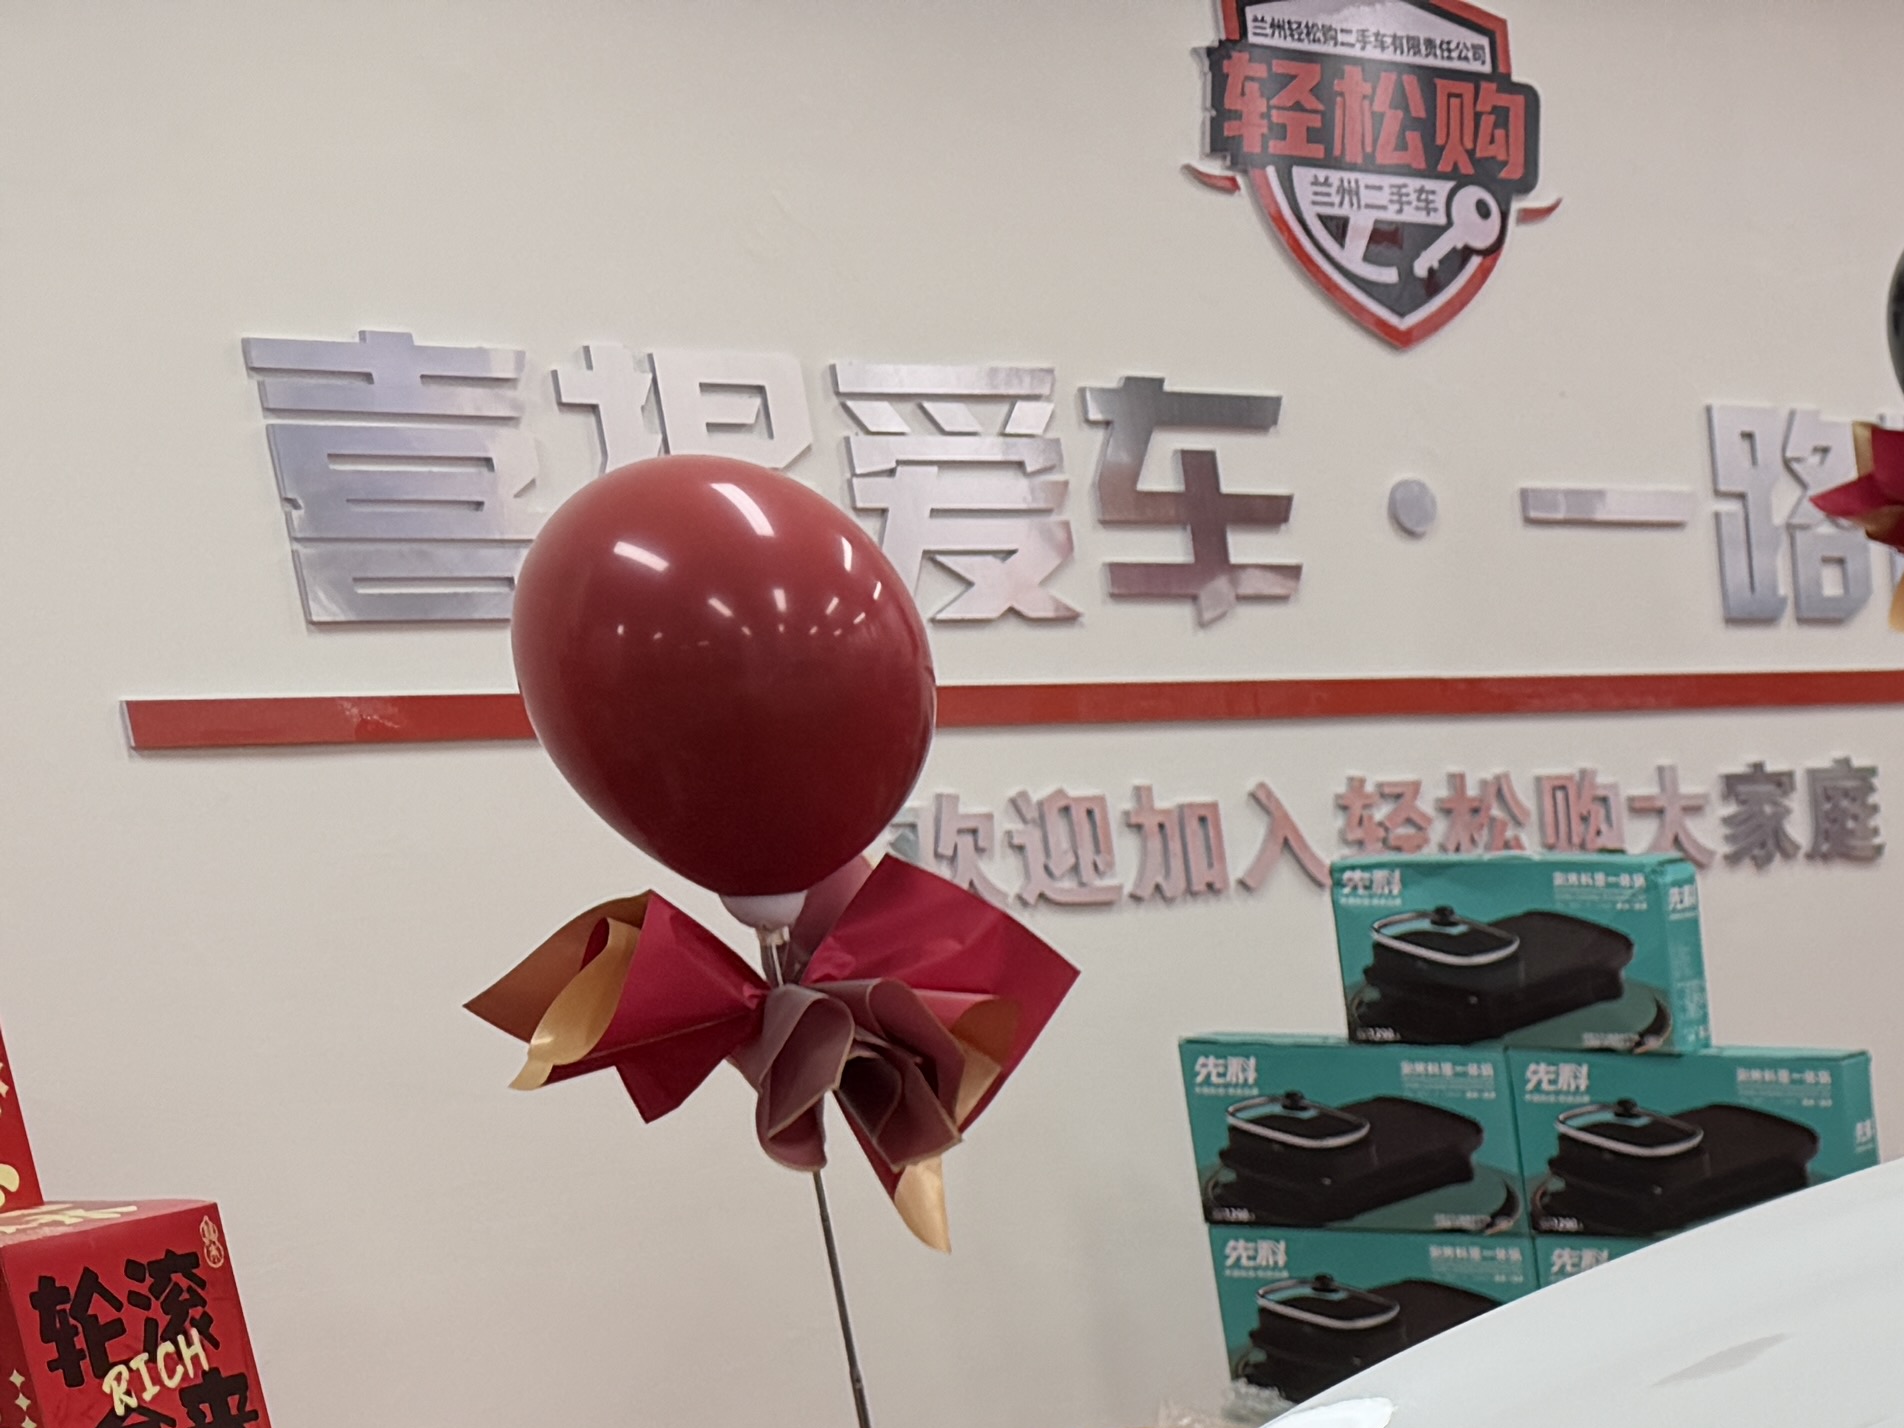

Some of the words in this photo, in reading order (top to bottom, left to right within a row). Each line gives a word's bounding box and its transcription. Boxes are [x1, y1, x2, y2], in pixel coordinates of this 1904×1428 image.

[1251, 15, 1488, 66] 兰州轻松购二手车有限责任公司
[1223, 50, 1525, 180] 轻松购
[1309, 174, 1440, 217] 兰州二手车
[1195, 1055, 1258, 1085] 先科
[1525, 1062, 1590, 1092] 先科
[1225, 1239, 1288, 1268] 先科
[102, 1328, 210, 1416] RICH
